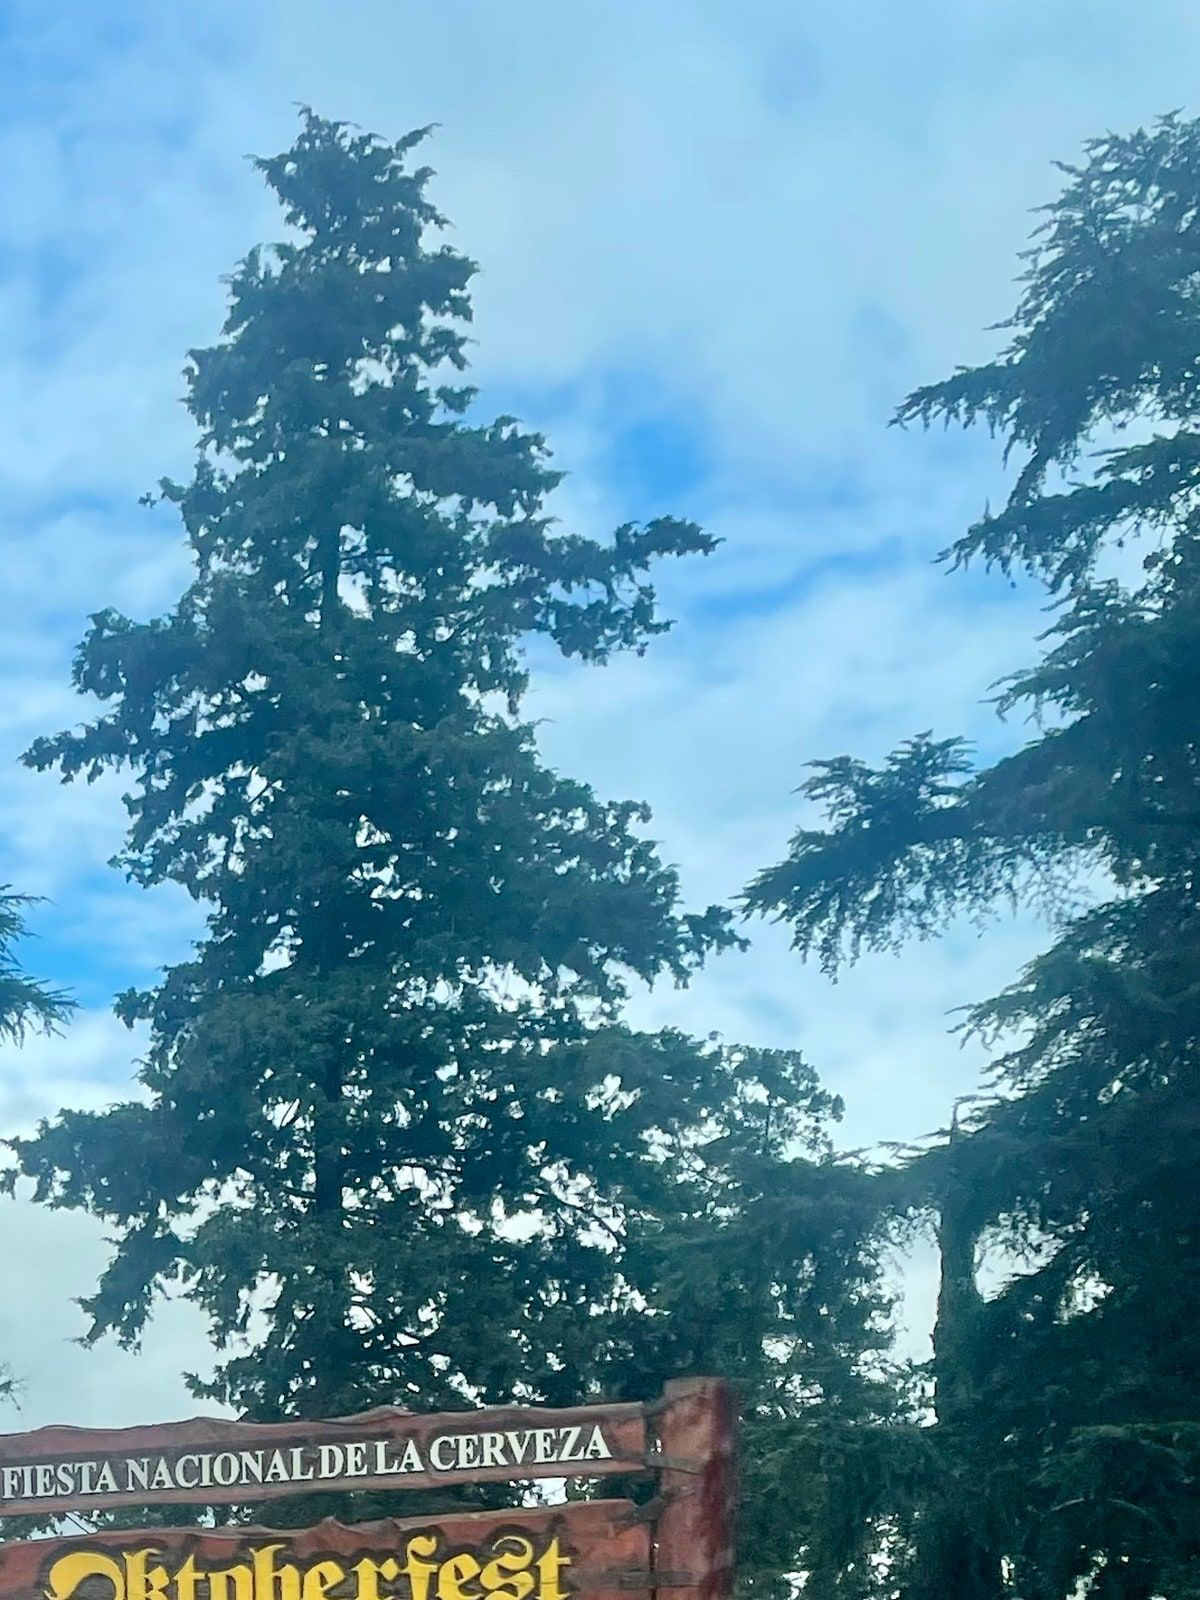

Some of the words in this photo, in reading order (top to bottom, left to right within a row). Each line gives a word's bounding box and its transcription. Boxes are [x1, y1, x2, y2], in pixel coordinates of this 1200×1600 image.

[1, 1460, 119, 1499] FIESTA
[126, 1447, 314, 1491] NACIONAL
[318, 1443, 368, 1479] DE
[374, 1439, 425, 1476] LA
[429, 1425, 613, 1472] CERVEZA
